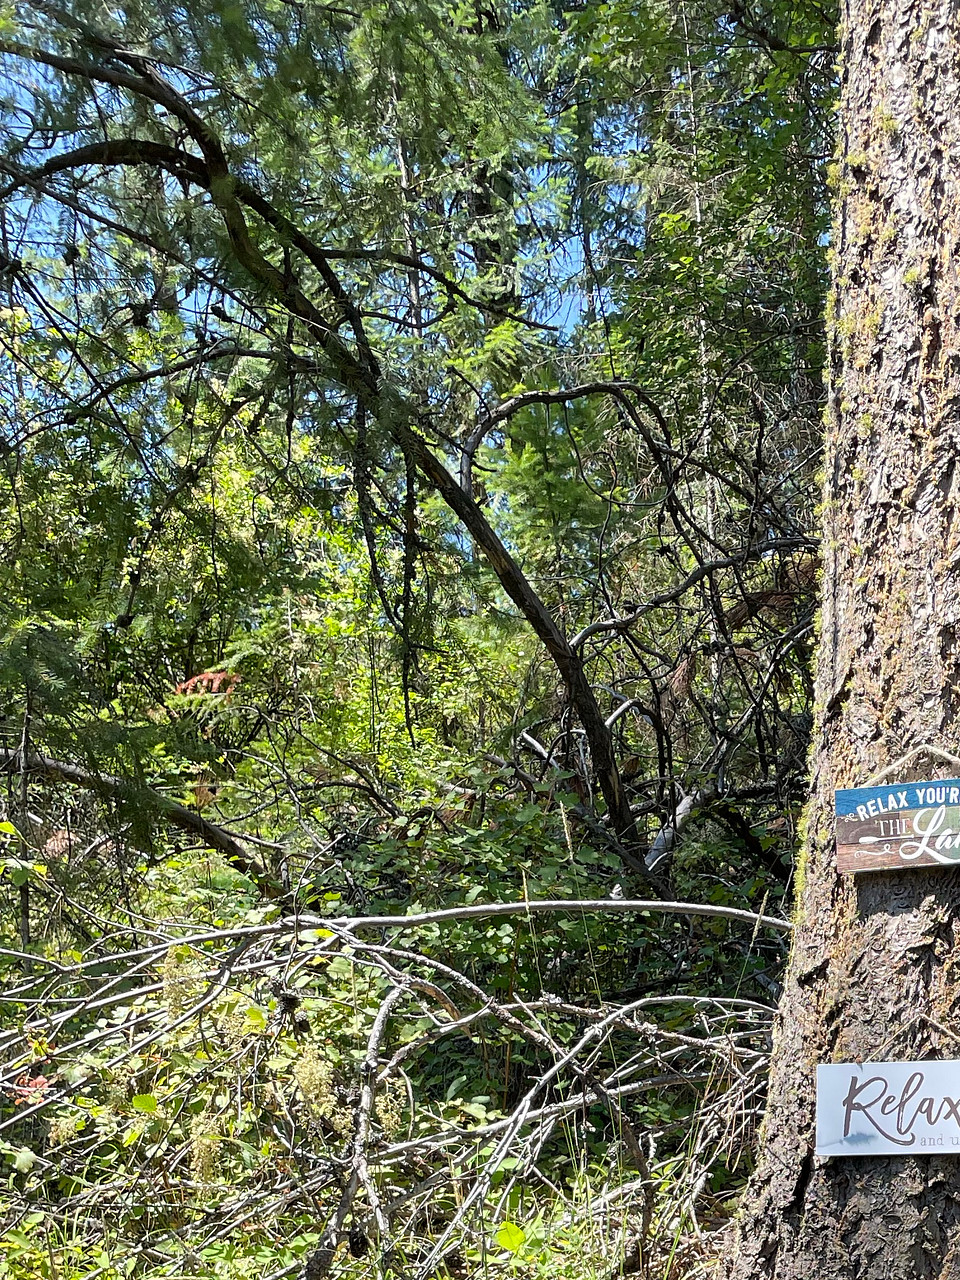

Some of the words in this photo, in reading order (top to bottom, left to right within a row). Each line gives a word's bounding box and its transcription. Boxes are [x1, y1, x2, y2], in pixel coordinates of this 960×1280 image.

[856, 791, 908, 821] RELAX
[876, 818, 912, 836] THE
[920, 1134, 944, 1147] and
